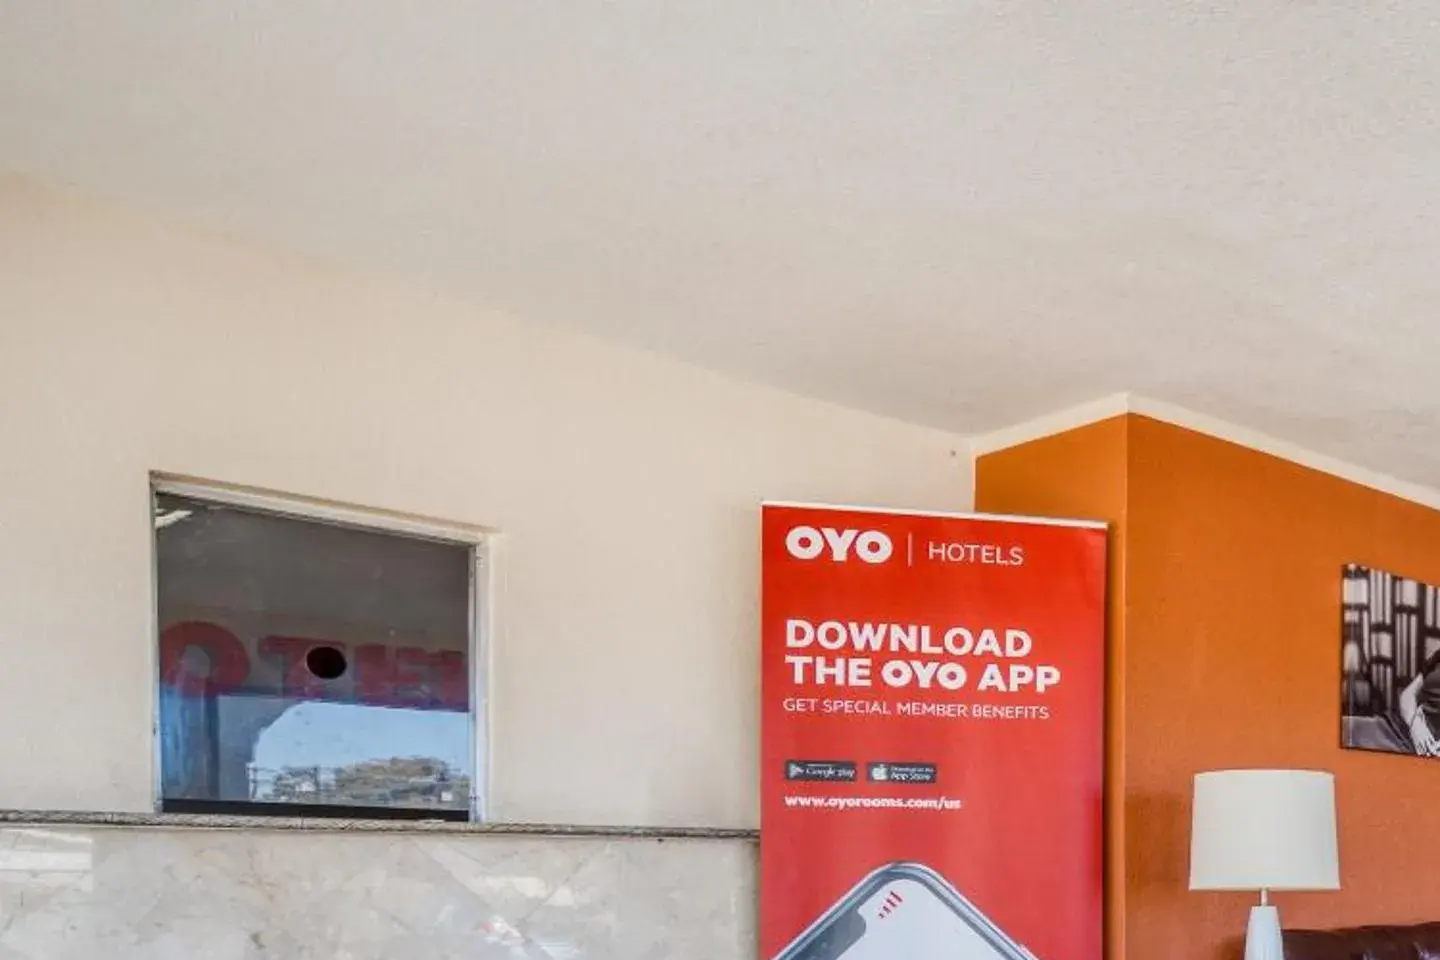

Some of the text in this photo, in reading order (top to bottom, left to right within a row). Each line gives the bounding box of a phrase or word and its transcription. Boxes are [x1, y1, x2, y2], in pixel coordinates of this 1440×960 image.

[786, 526, 893, 563] OYO
[928, 541, 1024, 566] HOTELS
[785, 619, 1032, 657] DOWNLOAD
[785, 655, 1061, 693] THE OYO APP
[783, 698, 1050, 720] GET SPECIAL MEMBER BENEFITS
[784, 794, 962, 811] www.oyorooms.com/us
